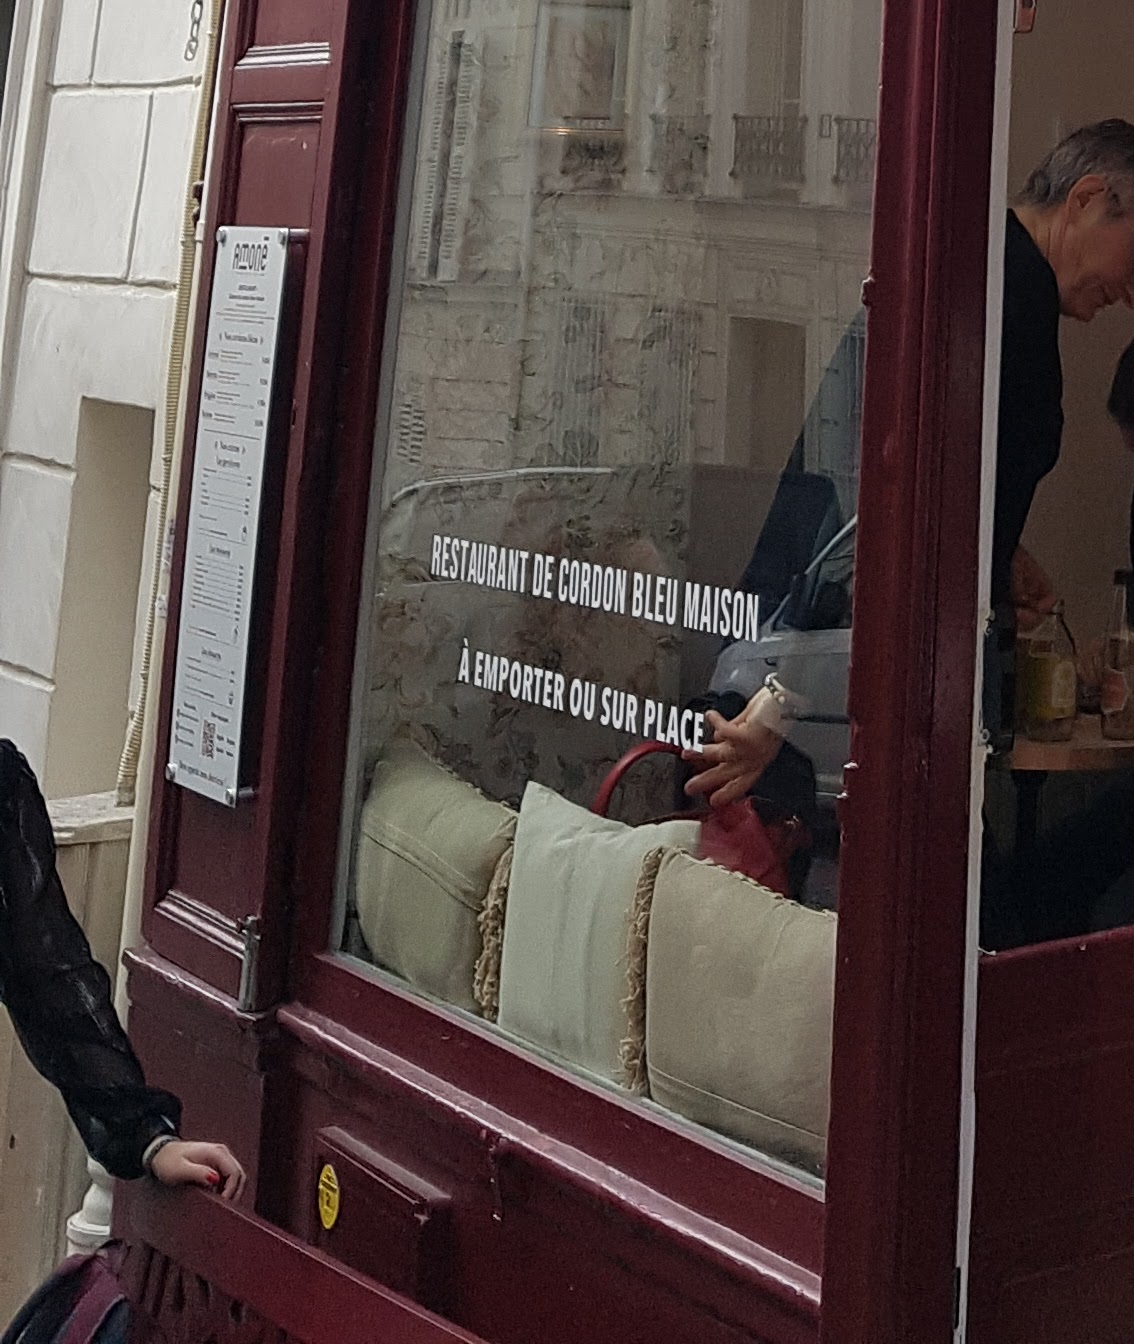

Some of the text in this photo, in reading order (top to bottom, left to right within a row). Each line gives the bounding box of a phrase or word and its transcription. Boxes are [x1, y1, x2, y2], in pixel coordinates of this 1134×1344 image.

[430, 534, 760, 643] RESTAURANT DE CORDON BLEU MAISON
[457, 637, 705, 754] À EMPORTER OU SUR PLACE
